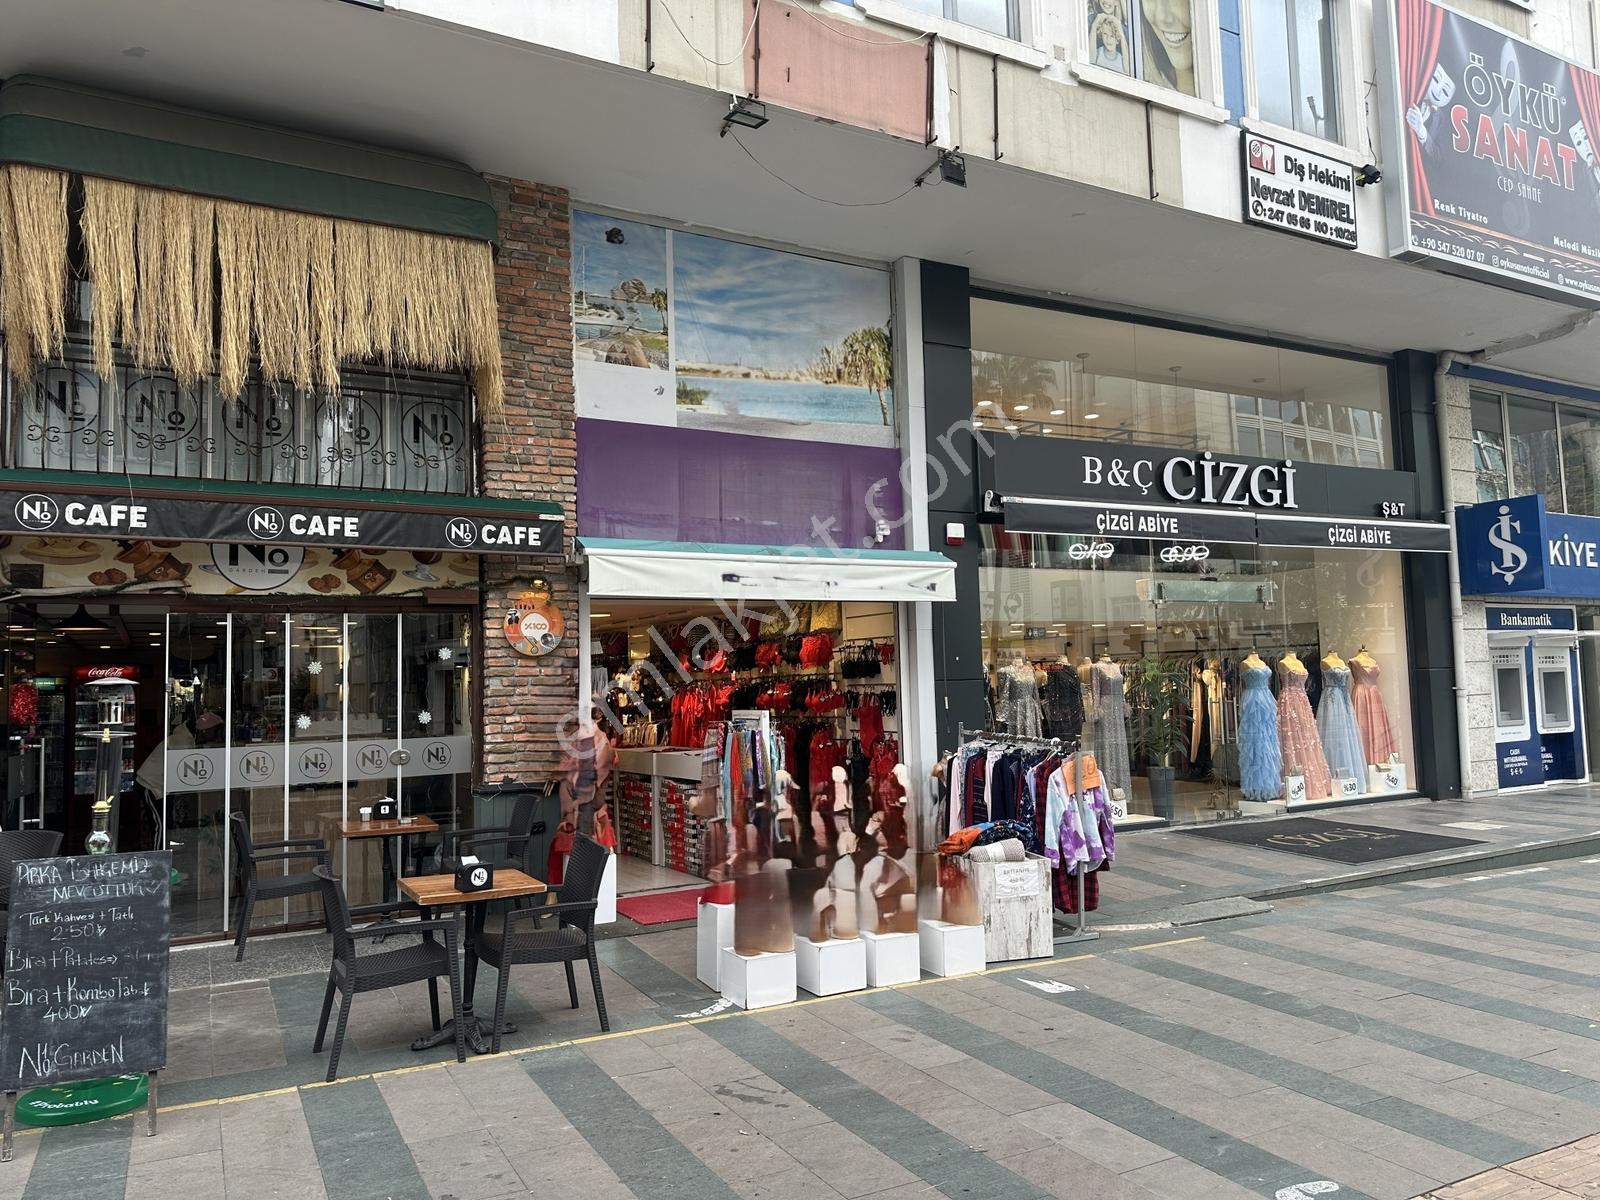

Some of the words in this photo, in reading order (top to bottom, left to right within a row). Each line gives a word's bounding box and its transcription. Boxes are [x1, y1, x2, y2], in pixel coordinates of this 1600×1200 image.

[1463, 51, 1561, 135] ÖYKÜ
[1450, 104, 1576, 191] SANAT
[1284, 154, 1306, 182] Diş
[1308, 162, 1351, 192] Hekimi
[1497, 175, 1514, 193] CEP
[1250, 175, 1296, 209] Nevzat
[1434, 198, 1456, 214] Renk
[1458, 205, 1489, 225] Tiyatro
[1421, 237, 1436, 250] +90
[1437, 240, 1451, 254] 547
[1452, 244, 1466, 258] 520
[1466, 248, 1476, 260] 07
[1475, 251, 1486, 263] 07
[1553, 235, 1579, 252] Melodi
[1081, 455, 1154, 495] B&Ç
[64, 502, 148, 528] CAFE
[1096, 510, 1135, 533] ÇİZGİ
[1138, 513, 1179, 533] ABİYE
[1382, 501, 1406, 519] Ş&T
[289, 513, 359, 539] CAFE
[481, 524, 542, 546] CAFE
[1328, 524, 1358, 545] ÇİZGİ
[1360, 527, 1392, 545] ABİYE
[524, 622, 548, 631] %100
[1500, 612, 1552, 627] Bankamatik
[1343, 782, 1357, 793] %30
[67, 977, 115, 1002] Kombo
[54, 1034, 125, 1069] GARDEN
